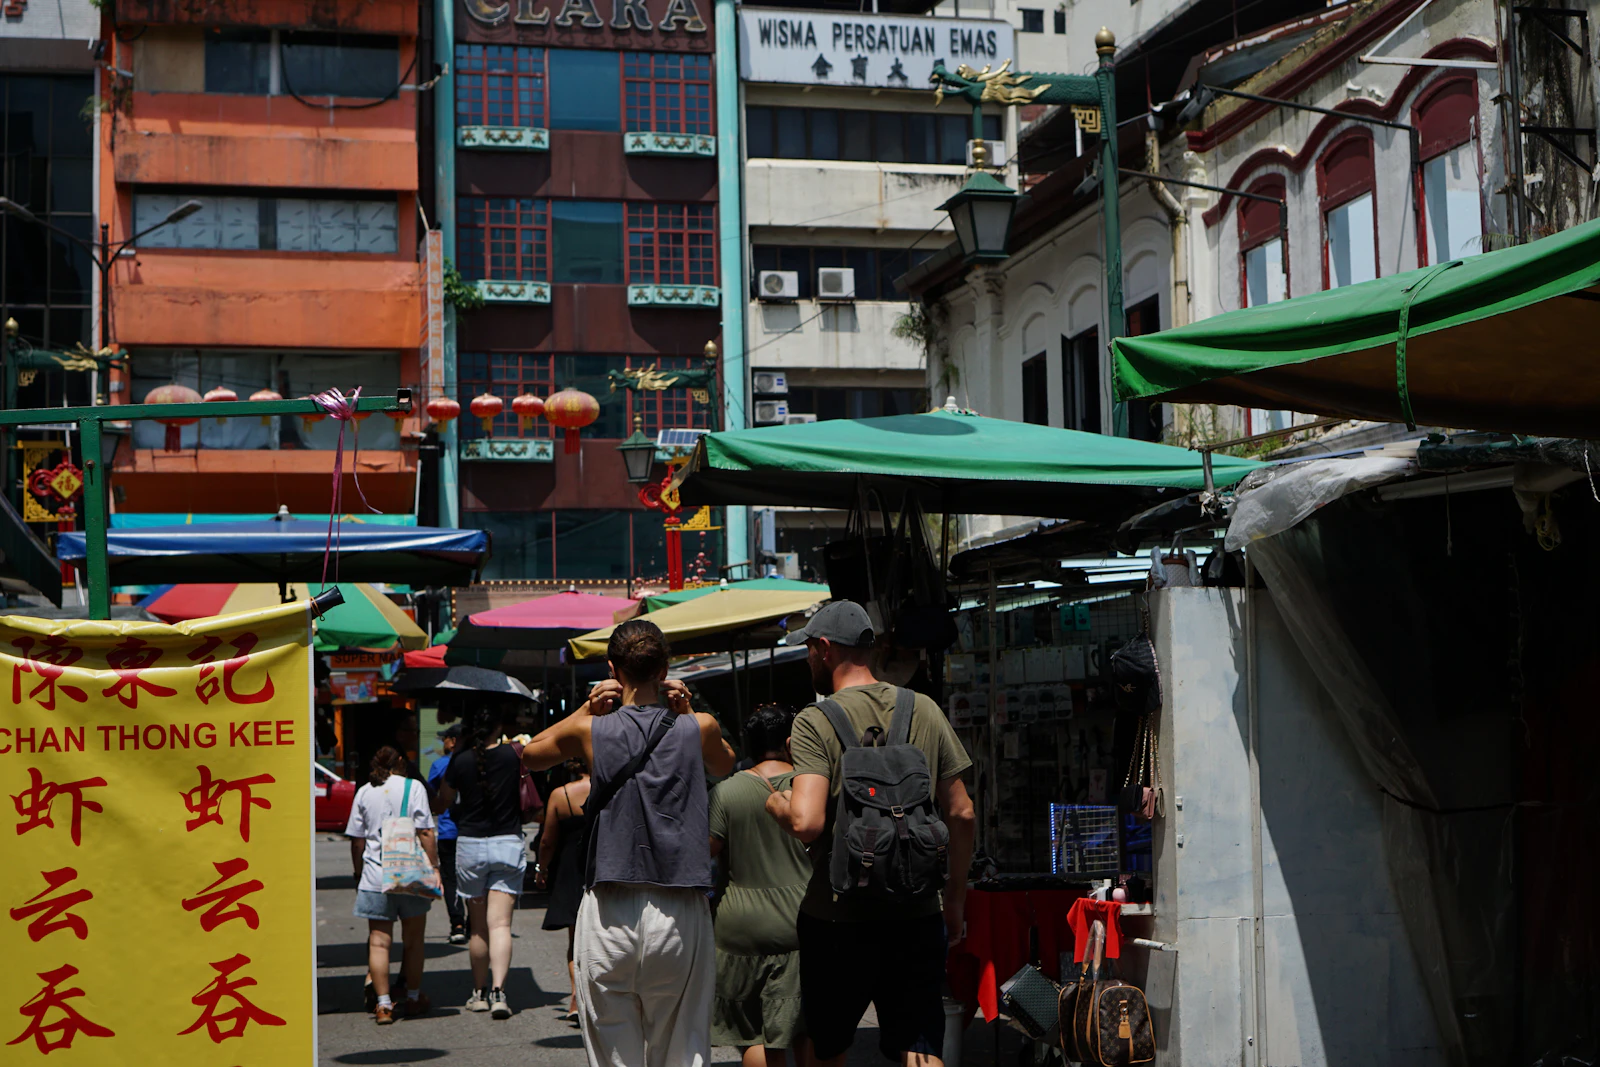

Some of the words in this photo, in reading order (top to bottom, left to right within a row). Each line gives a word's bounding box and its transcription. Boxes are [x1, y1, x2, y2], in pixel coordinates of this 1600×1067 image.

[758, 18, 816, 48] WISMA
[833, 22, 935, 54] PERSATUAN
[950, 28, 997, 55] EMAS
[430, 270, 441, 350] SUPER
[335, 652, 375, 663] SUPER
[97, 722, 217, 751] THONG
[229, 720, 295, 747] KEE
[7, 767, 116, 1055] 虾云吞
[178, 764, 287, 1044] 虾云吞
